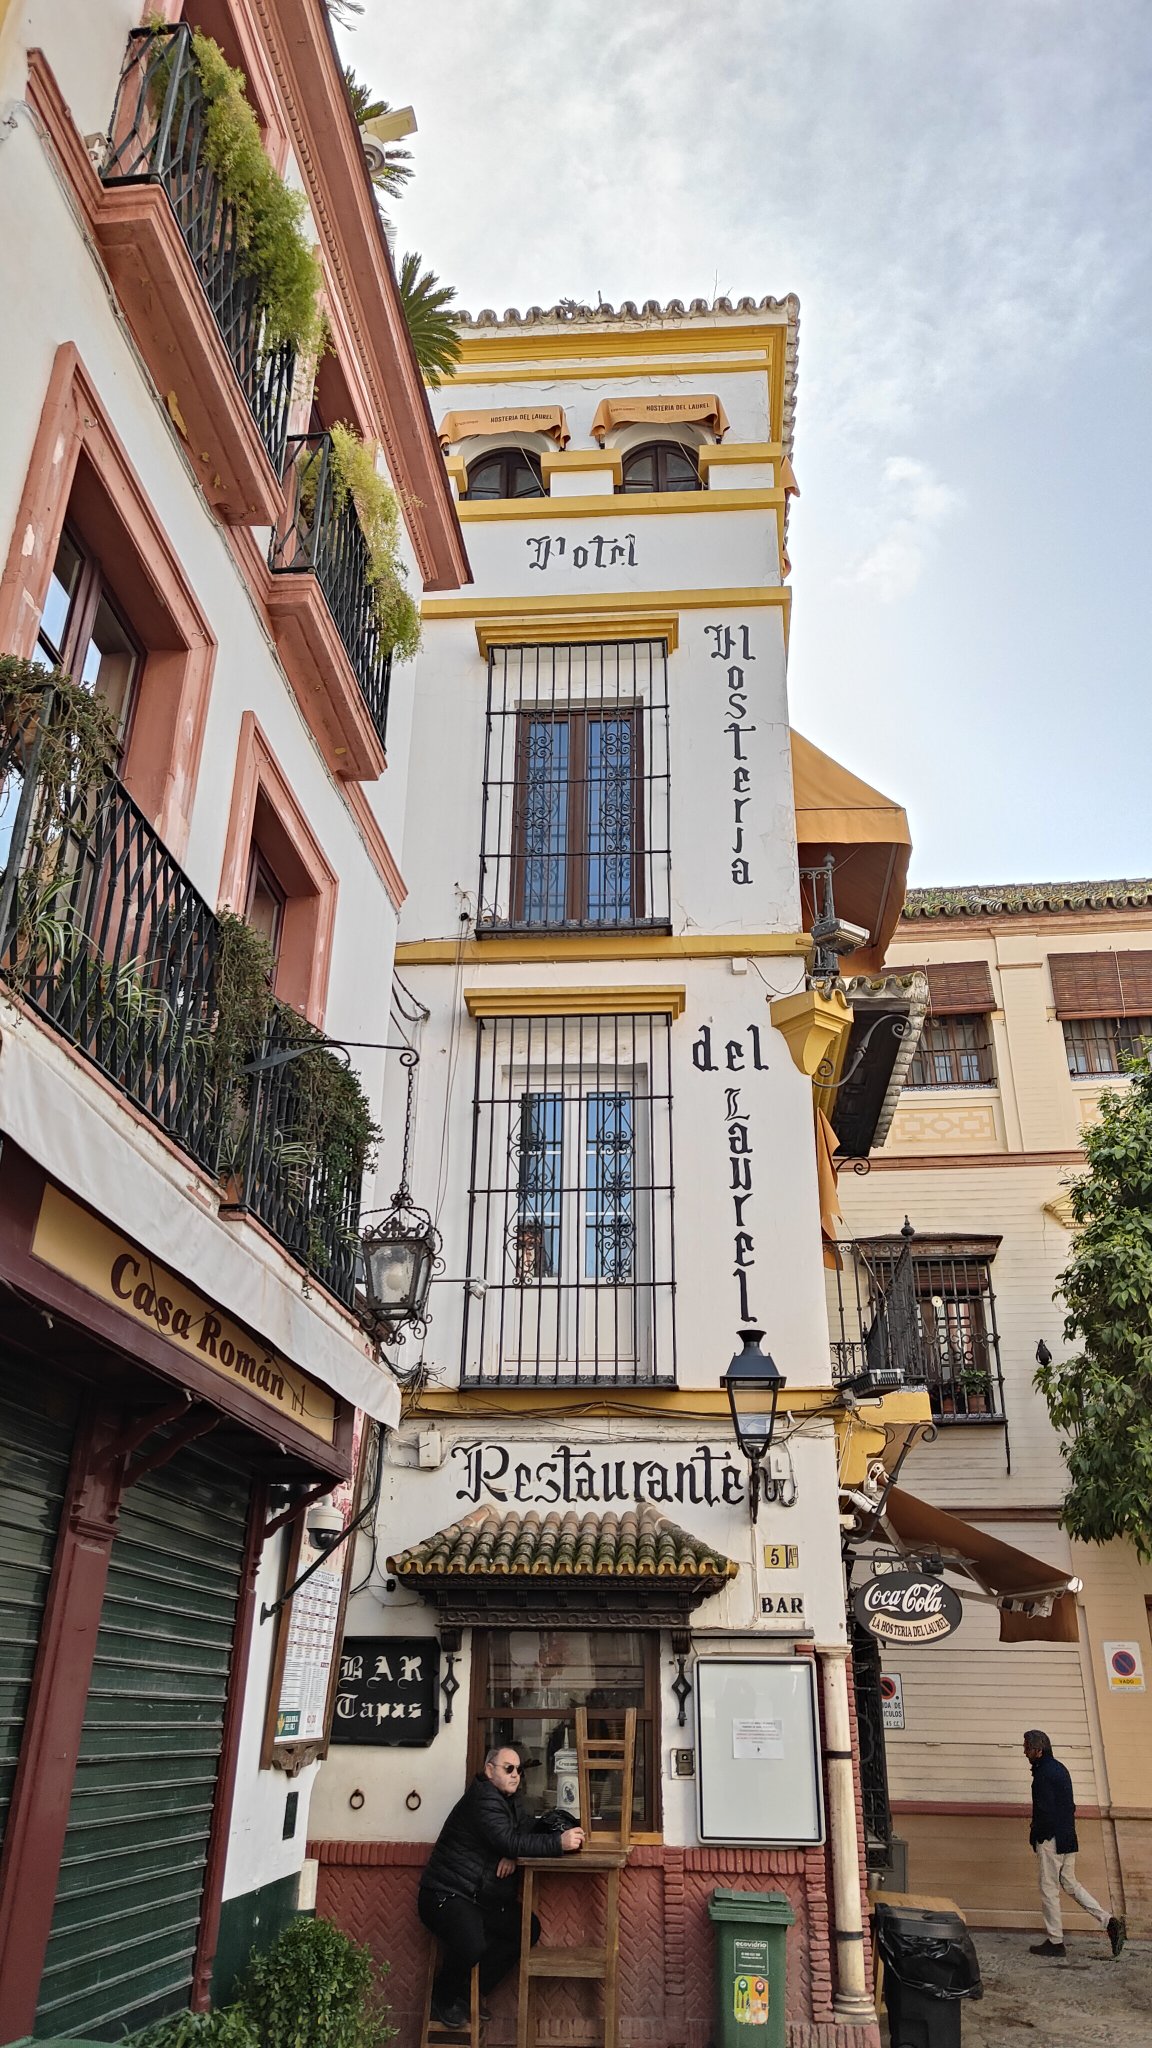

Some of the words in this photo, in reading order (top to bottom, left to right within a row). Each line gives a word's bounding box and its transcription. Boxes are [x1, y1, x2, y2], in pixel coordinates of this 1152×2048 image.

[490, 415, 518, 423] HOSTERIA
[645, 404, 675, 412] HOSTERIA
[688, 402, 710, 410] LAUREL
[692, 1024, 769, 1072] del
[724, 1087, 755, 1323] Laurel
[111, 1253, 191, 1339] Casa
[196, 1311, 284, 1401] Román
[451, 1441, 745, 1507] Restaurante
[770, 1548, 780, 1566] 5
[761, 1596, 804, 1614] BAR
[864, 1583, 947, 1613] Coca-Cola
[871, 1616, 881, 1630] LA
[880, 1620, 913, 1637] HOSTERIA
[913, 1625, 926, 1637] DEL
[926, 1617, 949, 1635] LAUREL
[338, 1655, 424, 1690] BAR
[336, 1692, 423, 1727] Tapas
[735, 1941, 767, 1949] ecovidrio
